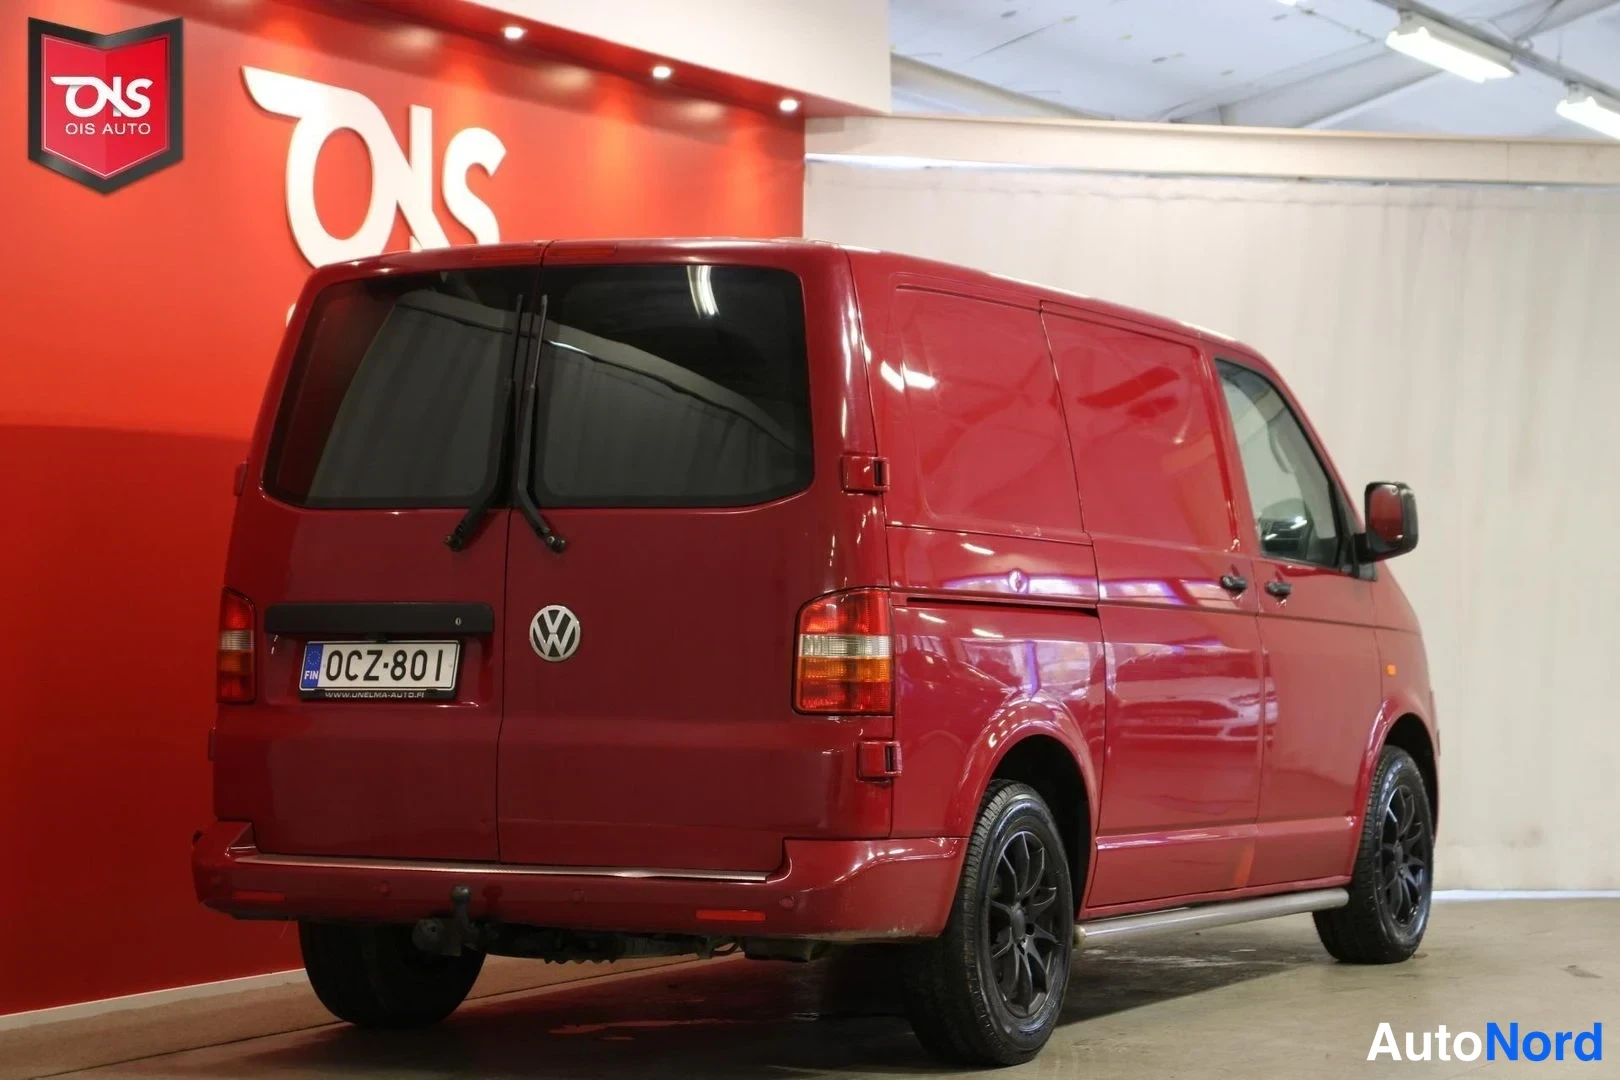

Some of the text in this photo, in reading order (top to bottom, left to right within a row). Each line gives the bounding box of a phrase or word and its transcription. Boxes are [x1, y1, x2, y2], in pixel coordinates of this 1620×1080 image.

[304, 649, 444, 682] FIN OCZ-801
[324, 691, 425, 699] WWW.UNELMA-AUTO.FI
